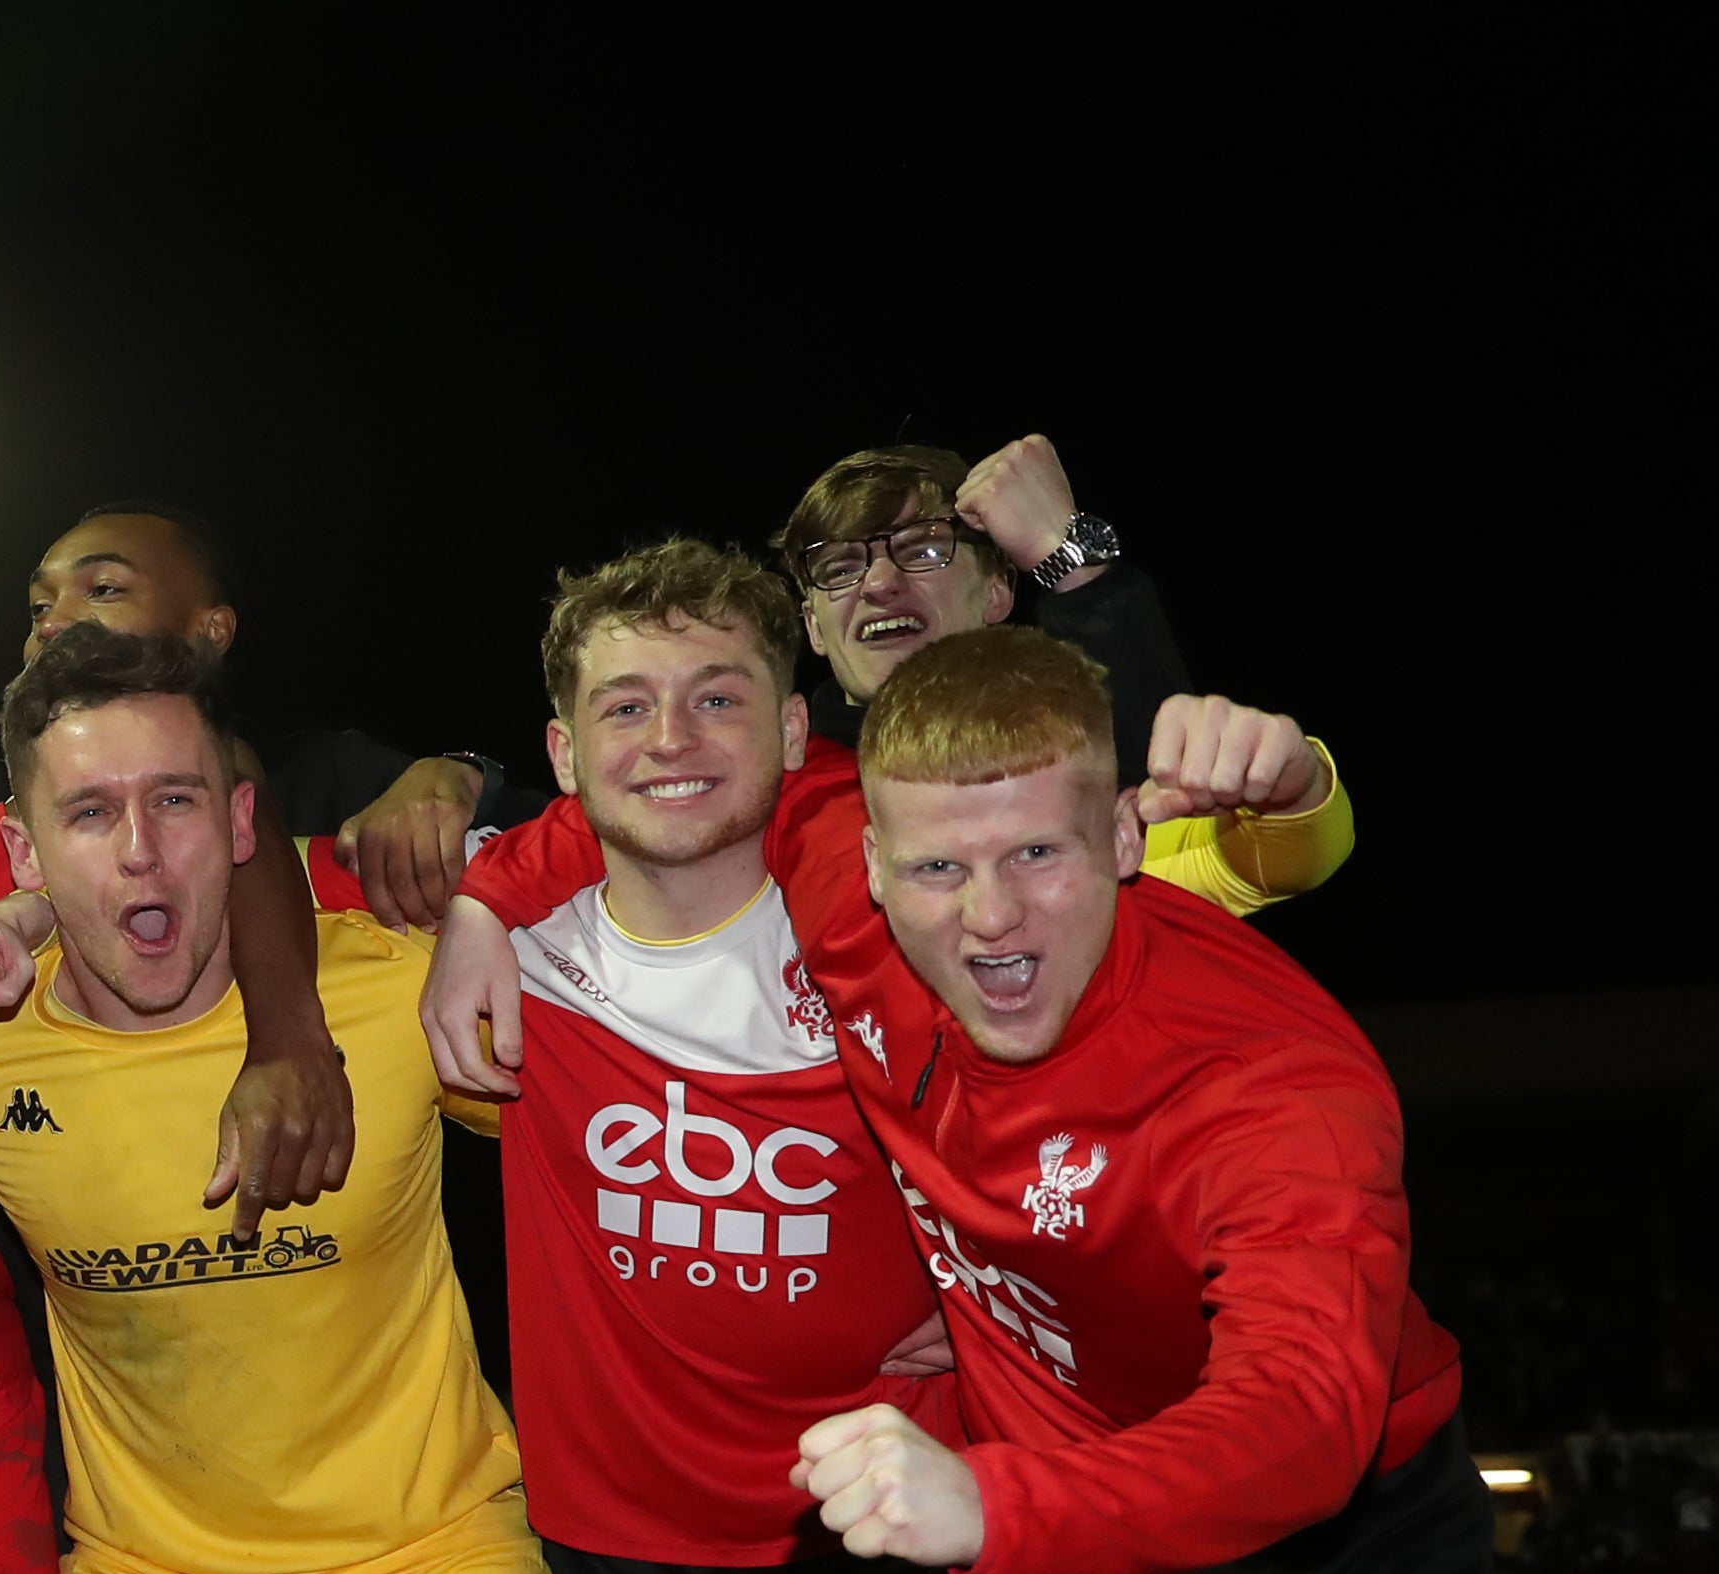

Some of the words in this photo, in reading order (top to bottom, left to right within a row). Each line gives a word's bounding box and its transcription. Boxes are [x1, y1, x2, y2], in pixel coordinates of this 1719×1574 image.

[585, 1080, 840, 1205] ebc
[54, 1253, 257, 1286] HEWITT
[95, 1231, 261, 1267] ADAM
[609, 1245, 818, 1303] group
